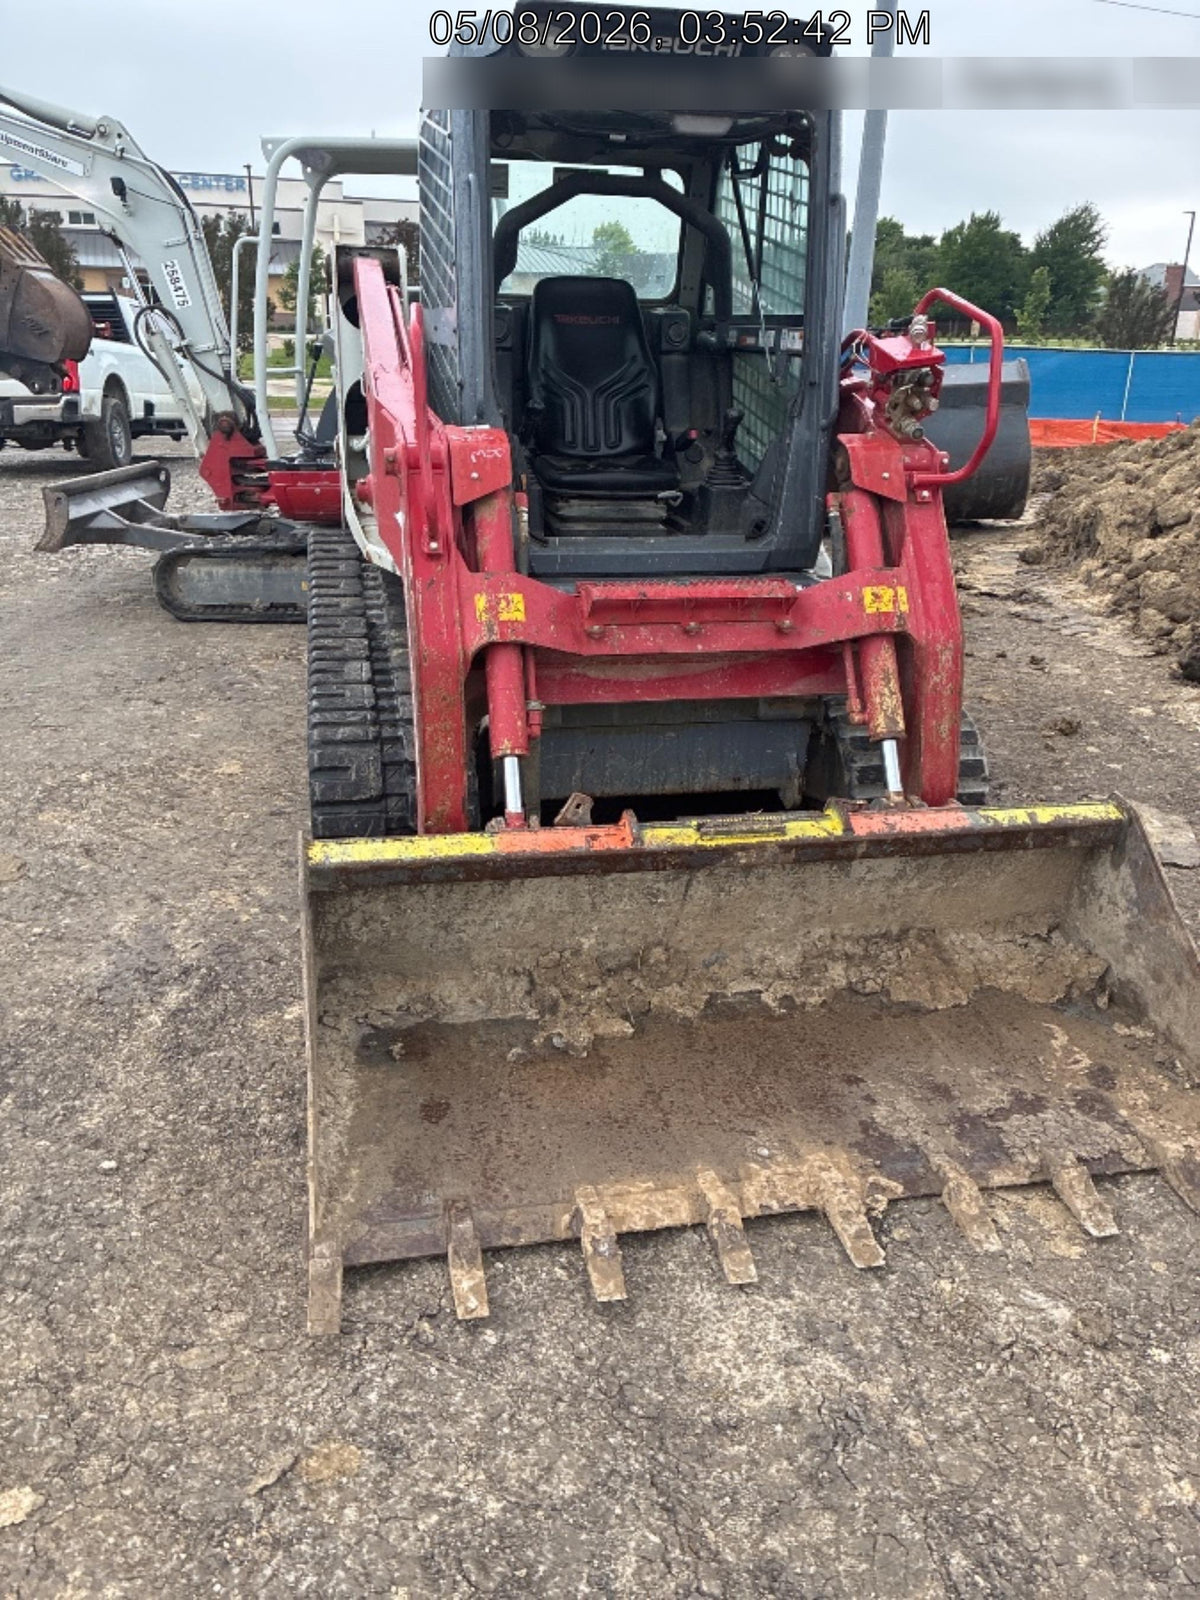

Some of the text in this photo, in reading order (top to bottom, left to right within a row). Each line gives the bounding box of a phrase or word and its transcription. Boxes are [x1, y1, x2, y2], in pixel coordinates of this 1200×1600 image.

[179, 174, 247, 192] CENTER
[165, 260, 189, 307] 258475
[553, 313, 620, 325] TAKEUCHI
